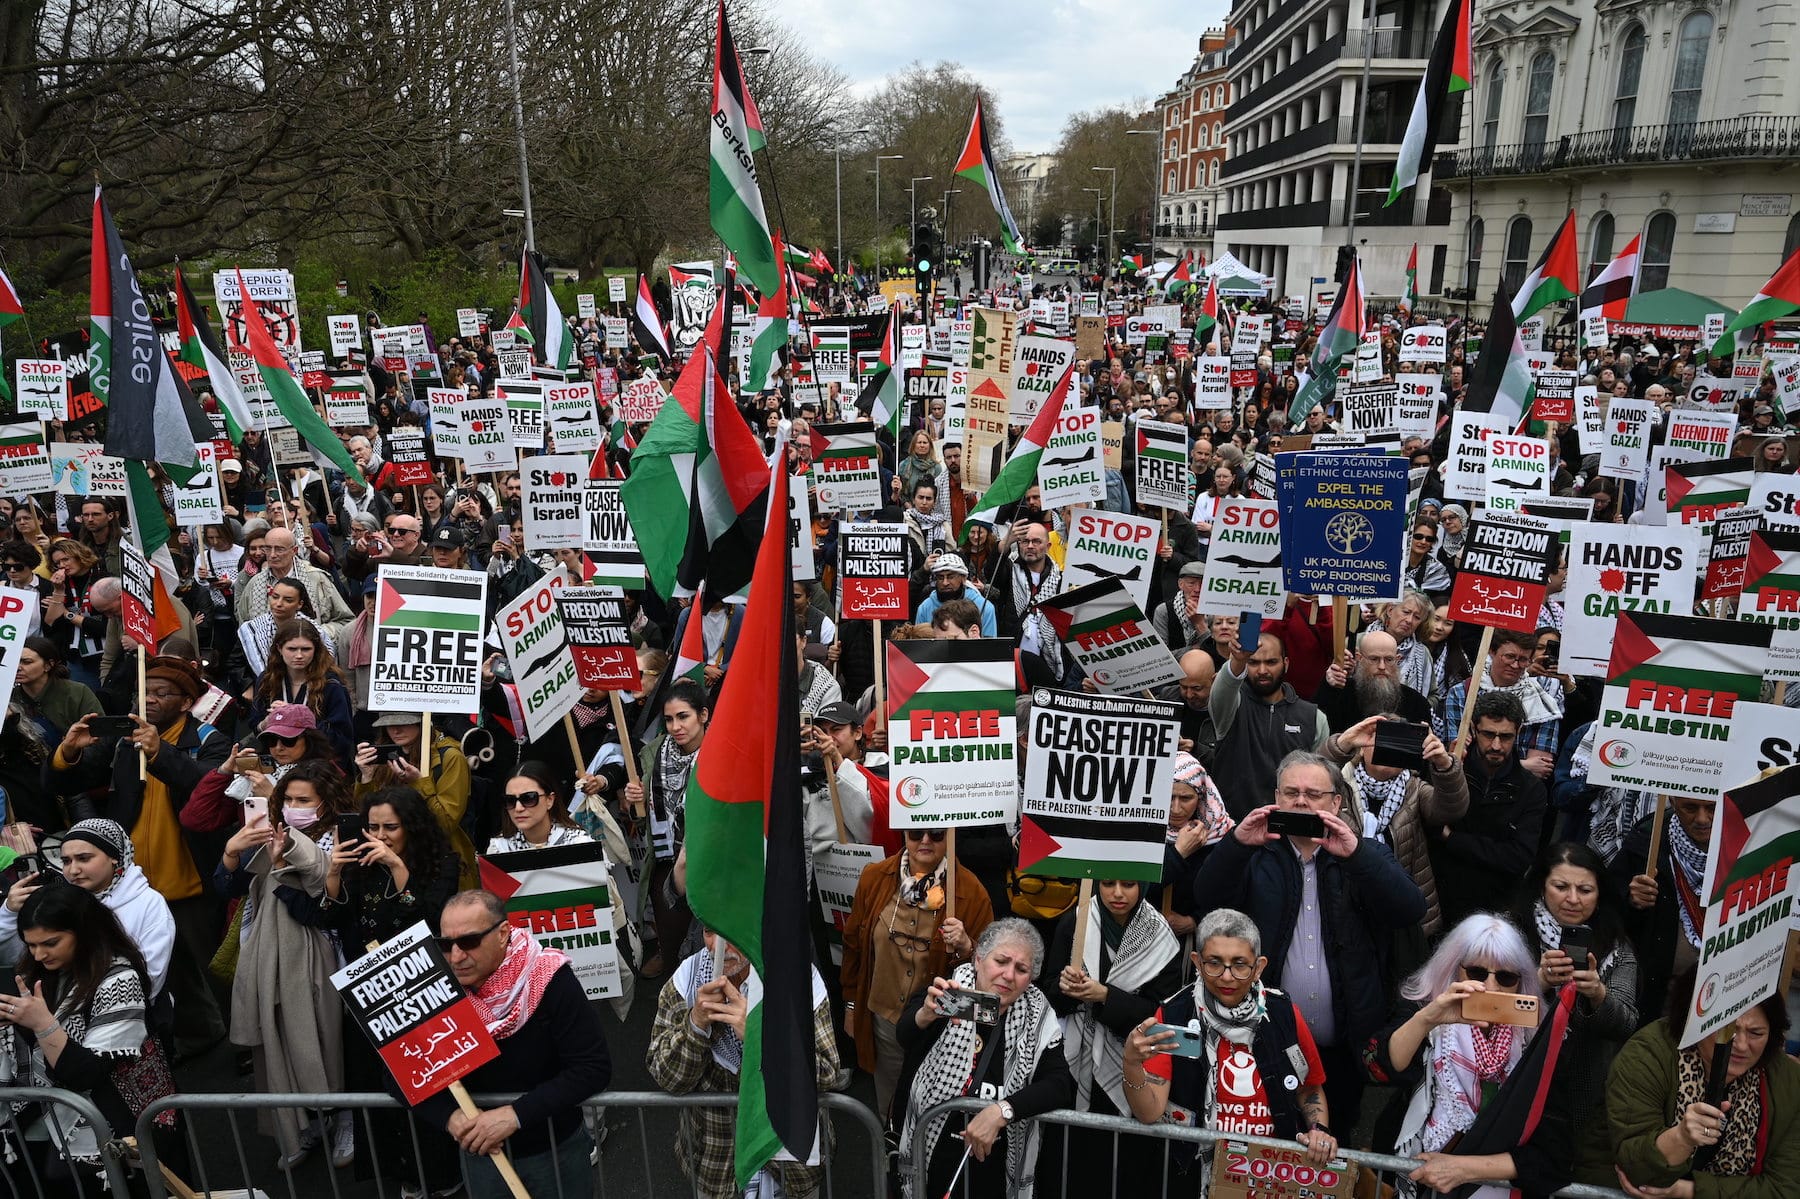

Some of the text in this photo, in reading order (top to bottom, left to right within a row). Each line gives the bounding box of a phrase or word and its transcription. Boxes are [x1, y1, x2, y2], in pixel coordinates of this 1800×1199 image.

[223, 287, 282, 297] CHDREN
[1612, 322, 1700, 339] Socialist Worker
[815, 351, 848, 364] FREE
[1021, 347, 1066, 366] HANDS
[21, 363, 63, 375] STOP
[21, 374, 63, 383] ARMING
[1200, 375, 1229, 385] Arming
[1539, 377, 1573, 386] FREEDOM
[549, 387, 589, 400] STOP
[628, 380, 659, 397] STOP
[1202, 384, 1227, 393] Israel
[1536, 389, 1573, 399] PALESTINE
[21, 399, 64, 409] ISRAEL
[431, 392, 464, 405] STOP
[551, 399, 592, 411] ARMING
[621, 396, 665, 408] CRUEL
[1345, 392, 1398, 411] CEASEFIRE
[1400, 397, 1434, 409] Arming
[461, 407, 504, 422] HANDS
[618, 407, 662, 420] MONST
[1352, 407, 1393, 430] NOW!
[1399, 409, 1431, 419] Israel
[1611, 407, 1647, 423] HANDS
[468, 432, 505, 446] GAZA!
[556, 428, 597, 440] ISRAEL
[1610, 433, 1642, 449] GAZA!
[1672, 423, 1730, 443] DEFEND THE
[391, 440, 424, 451] FREEDOM
[1492, 440, 1545, 459] STOP
[392, 451, 427, 463] PALESTINE
[823, 455, 870, 473] FREE
[1313, 457, 1391, 468] JEWS AGAINST
[400, 464, 424, 475] الحرية
[1138, 456, 1186, 484] FREE
[1299, 467, 1404, 480] ETHNIC CLEANSING
[1491, 458, 1546, 474] ARMING
[399, 471, 429, 483] لفلسطين
[817, 471, 878, 483] PALESTINE
[1043, 470, 1101, 491] ISRAEL
[90, 482, 126, 492] genoc
[1138, 476, 1186, 495] PALESTINE
[1317, 482, 1384, 496] EXPEL THE
[177, 497, 218, 511] ISRAEL
[528, 489, 582, 505] Arming
[585, 490, 624, 512] CEASEF
[1304, 497, 1393, 511] AMBASSADOR
[1522, 497, 1545, 505] Palestine
[1546, 499, 1567, 507] Solidarity
[533, 505, 580, 521] Israel
[1222, 505, 1279, 529] STO
[1485, 512, 1549, 529] Socialist Worker
[851, 525, 900, 533] Socialist Worker
[1078, 515, 1153, 544] STOP
[1718, 518, 1760, 537] FREEDOM
[848, 536, 901, 553] FREEDOM
[1218, 528, 1280, 546] ARMIN
[1474, 525, 1549, 553] FREEDOM
[869, 552, 880, 560] for
[1074, 537, 1149, 562] ARMING
[1502, 547, 1516, 558] for
[1582, 541, 1683, 571] HANDS
[845, 559, 905, 576] PALESTINE
[1304, 557, 1388, 570] UK POLITICIANS:
[1463, 550, 1546, 582] PALESTINE
[383, 568, 483, 583] Palestine Solidarity Campaign
[1299, 569, 1392, 583] STOP ENDORSING
[562, 590, 614, 598] Socialist Worker
[855, 580, 894, 595] الحرية
[1208, 577, 1281, 597] ISRAEL
[1310, 582, 1378, 595] WAR CRIMES.
[1472, 579, 1525, 600] الحرية
[506, 576, 563, 638] STOP
[562, 602, 622, 619] FREEDOM
[850, 596, 901, 612] لفلسطين
[1460, 598, 1528, 620] لفلسطين
[589, 619, 599, 628] for
[514, 607, 561, 659] ARMIN
[567, 626, 630, 644] PALESTINE
[1073, 619, 1144, 652] FREE
[376, 627, 479, 667] FREE
[1077, 634, 1161, 666] PALESTINE
[583, 650, 624, 667] الحرية
[374, 663, 476, 684] PALESTINE
[583, 667, 633, 682] لفلسطين
[374, 682, 475, 694] END ISRAELI OCCUPATION
[526, 659, 576, 714] ISRAE
[1054, 694, 1175, 716] PALESTINE SOLIDARITY CAMPAIGN
[1625, 678, 1739, 720] FREE
[909, 709, 1000, 742] FREE
[1602, 709, 1730, 742] PALESTIN
[1034, 712, 1174, 758] CEASEFIRE
[894, 743, 1014, 766] PALESTINE
[1640, 759, 1704, 775] Palestinian Forum
[1045, 751, 1157, 806] NOW!
[1610, 773, 1720, 796] WWW.PFBUK.COM
[934, 789, 1015, 800] Palestinian Forum Britain
[910, 810, 1004, 822] WWW.PFBUK.COM
[1026, 799, 1165, 820] FREE PALESTINE END APARTHEID
[1718, 856, 1794, 928] FREE
[1702, 895, 1794, 966] PALESTINE
[346, 934, 415, 980] Socialist Worker
[351, 945, 436, 1010] FREEDOM
[393, 988, 409, 1004] for
[367, 975, 459, 1042] PALESTINE
[1700, 983, 1769, 1034] WWW.PFBUK.COM
[400, 1015, 459, 1059] الحرية
[411, 1031, 480, 1089] لفلسطين
[1217, 1103, 1245, 1116] ave
[1215, 1116, 1275, 1136] hildren
[1260, 1148, 1302, 1164] OVER
[1225, 1153, 1340, 1188] 20,000
